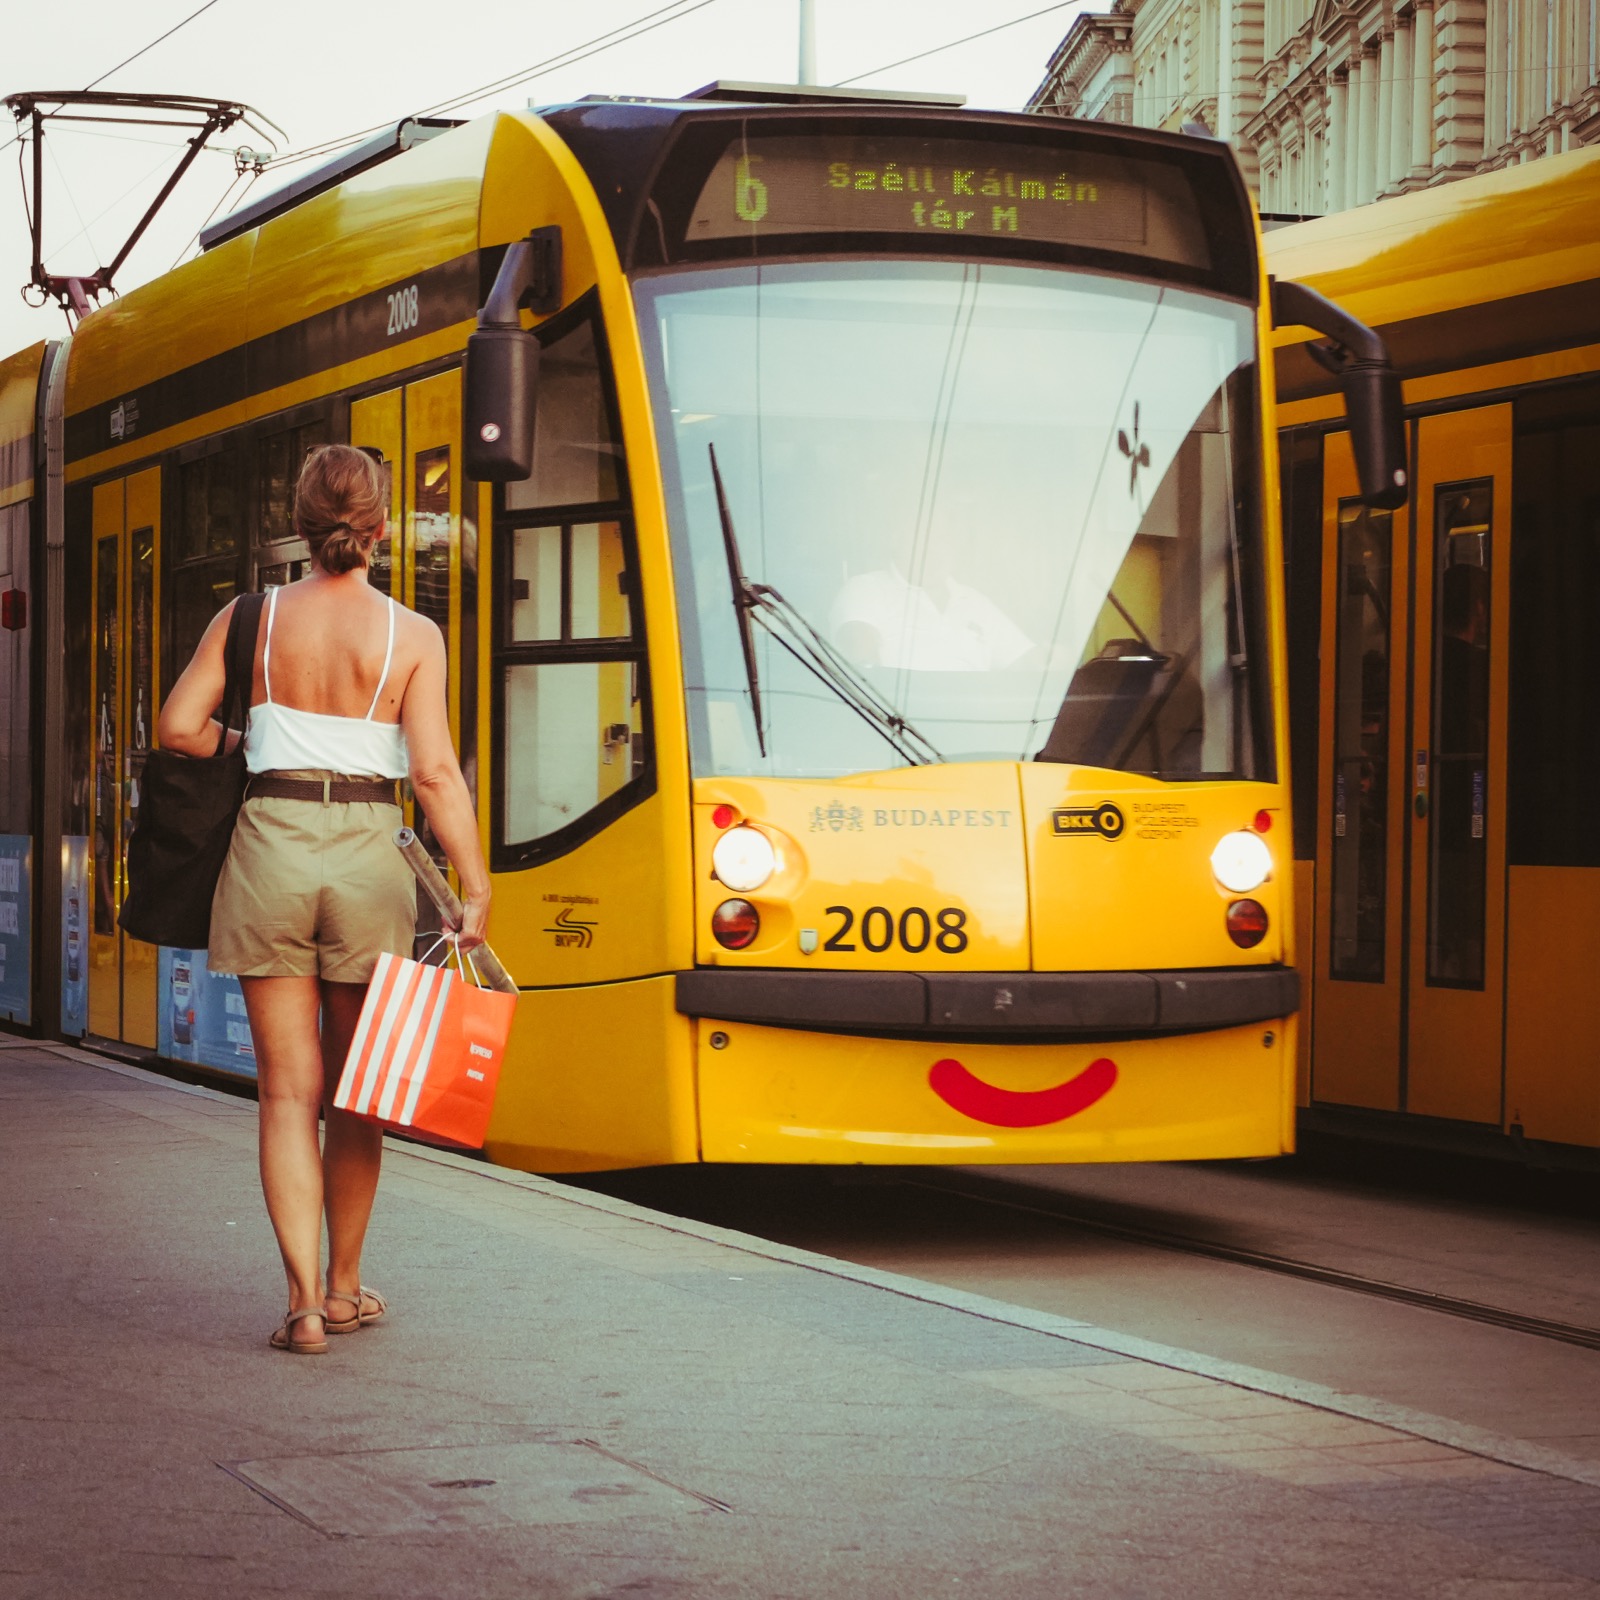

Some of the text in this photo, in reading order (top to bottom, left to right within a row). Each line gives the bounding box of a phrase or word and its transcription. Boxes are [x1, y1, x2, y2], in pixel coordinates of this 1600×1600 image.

[735, 155, 768, 221] 6
[828, 163, 1098, 202] Széll Kálmán
[912, 199, 1019, 232] tér M
[386, 284, 419, 336] 2008
[873, 808, 1012, 827] BUDAPEST
[1057, 814, 1096, 829] BKK
[823, 905, 968, 954] 2008
